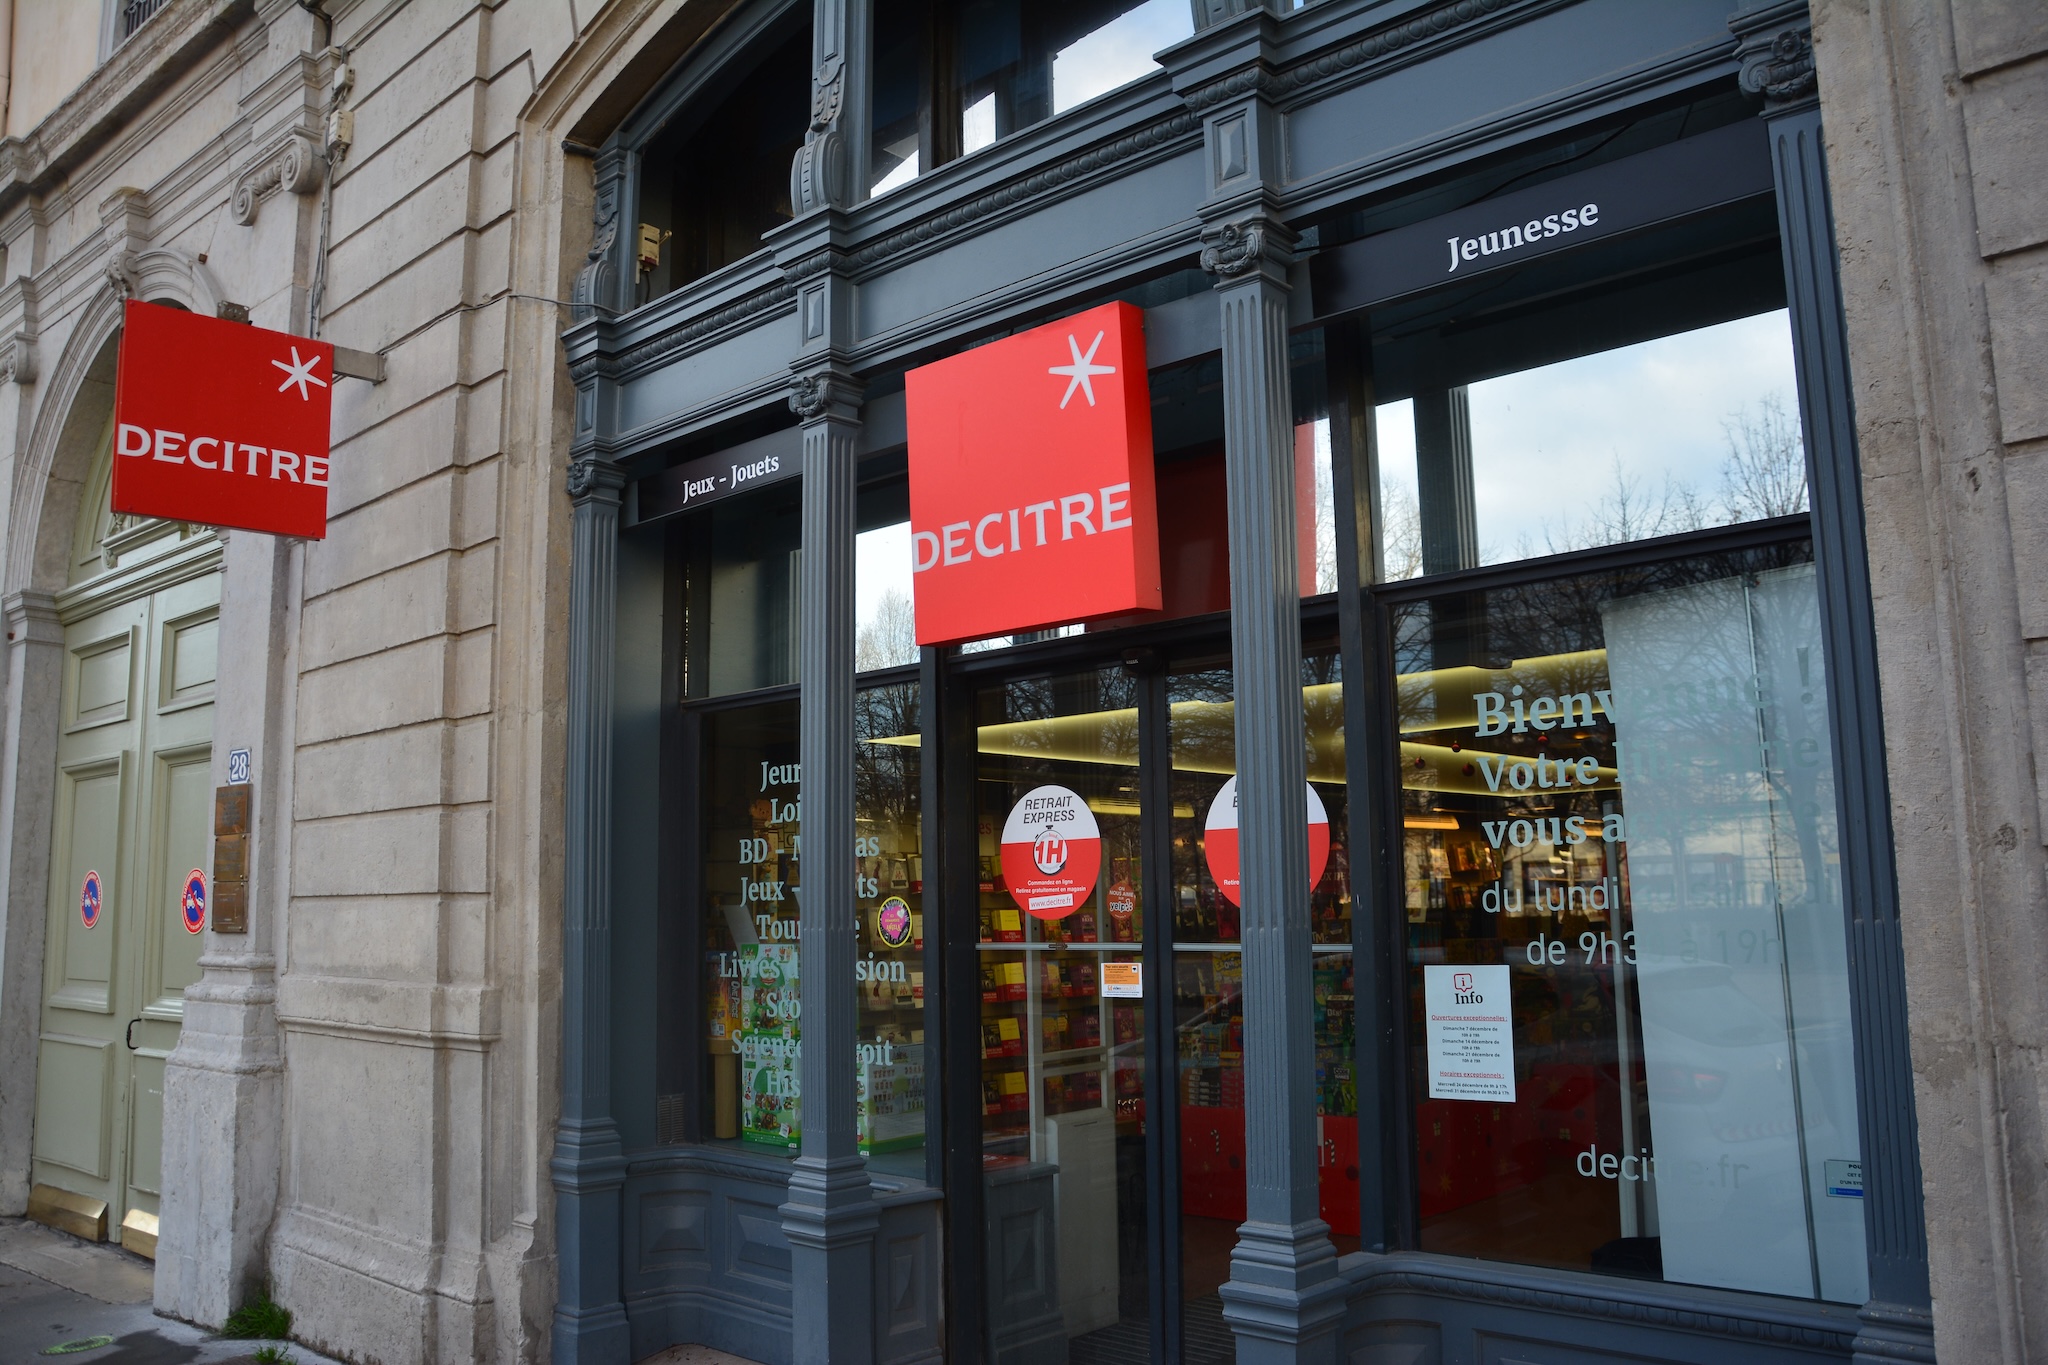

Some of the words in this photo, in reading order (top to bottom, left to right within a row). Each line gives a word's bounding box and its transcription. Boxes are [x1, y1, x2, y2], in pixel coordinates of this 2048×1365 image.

[1447, 203, 1599, 273] Jeunesse
[117, 423, 329, 488] DECITRE
[682, 476, 715, 504] Jeux
[730, 455, 780, 489] Jouets
[911, 481, 1133, 573] DECITRE
[231, 754, 247, 780] 28
[1475, 750, 1600, 793] Votre
[1023, 810, 1076, 824] EXPRESS
[1024, 796, 1073, 811] RETRAIT
[1481, 813, 1587, 850] vous
[739, 838, 768, 864] BD
[1036, 840, 1064, 864] 1H
[739, 877, 785, 908] Jeux
[1031, 897, 1071, 908] www.decitre.fr
[1109, 901, 1125, 913] yelp
[1481, 882, 1522, 914] du
[1534, 876, 1619, 912] lundi
[719, 950, 781, 979] Livres
[1526, 933, 1567, 966] de
[1455, 991, 1484, 1005] Info
